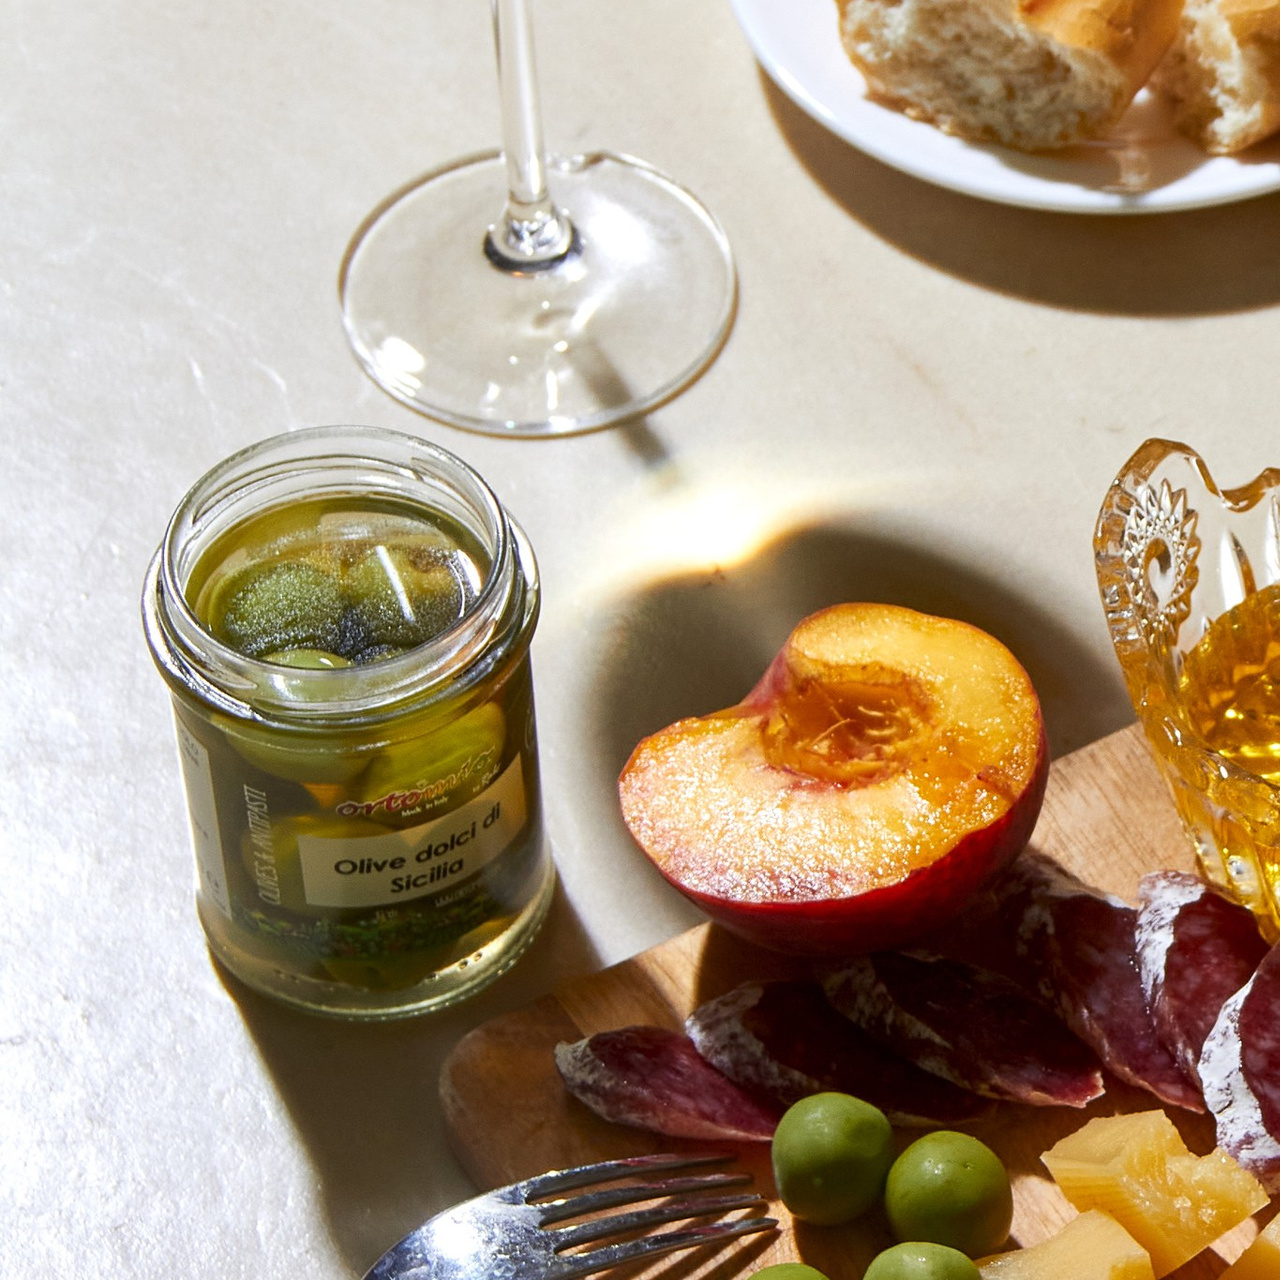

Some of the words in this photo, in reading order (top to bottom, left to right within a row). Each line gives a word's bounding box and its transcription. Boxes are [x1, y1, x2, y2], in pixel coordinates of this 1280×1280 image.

[333, 854, 407, 876] Olive
[415, 822, 477, 865] dolci
[482, 801, 501, 830] di
[389, 857, 465, 895] Sicilia
